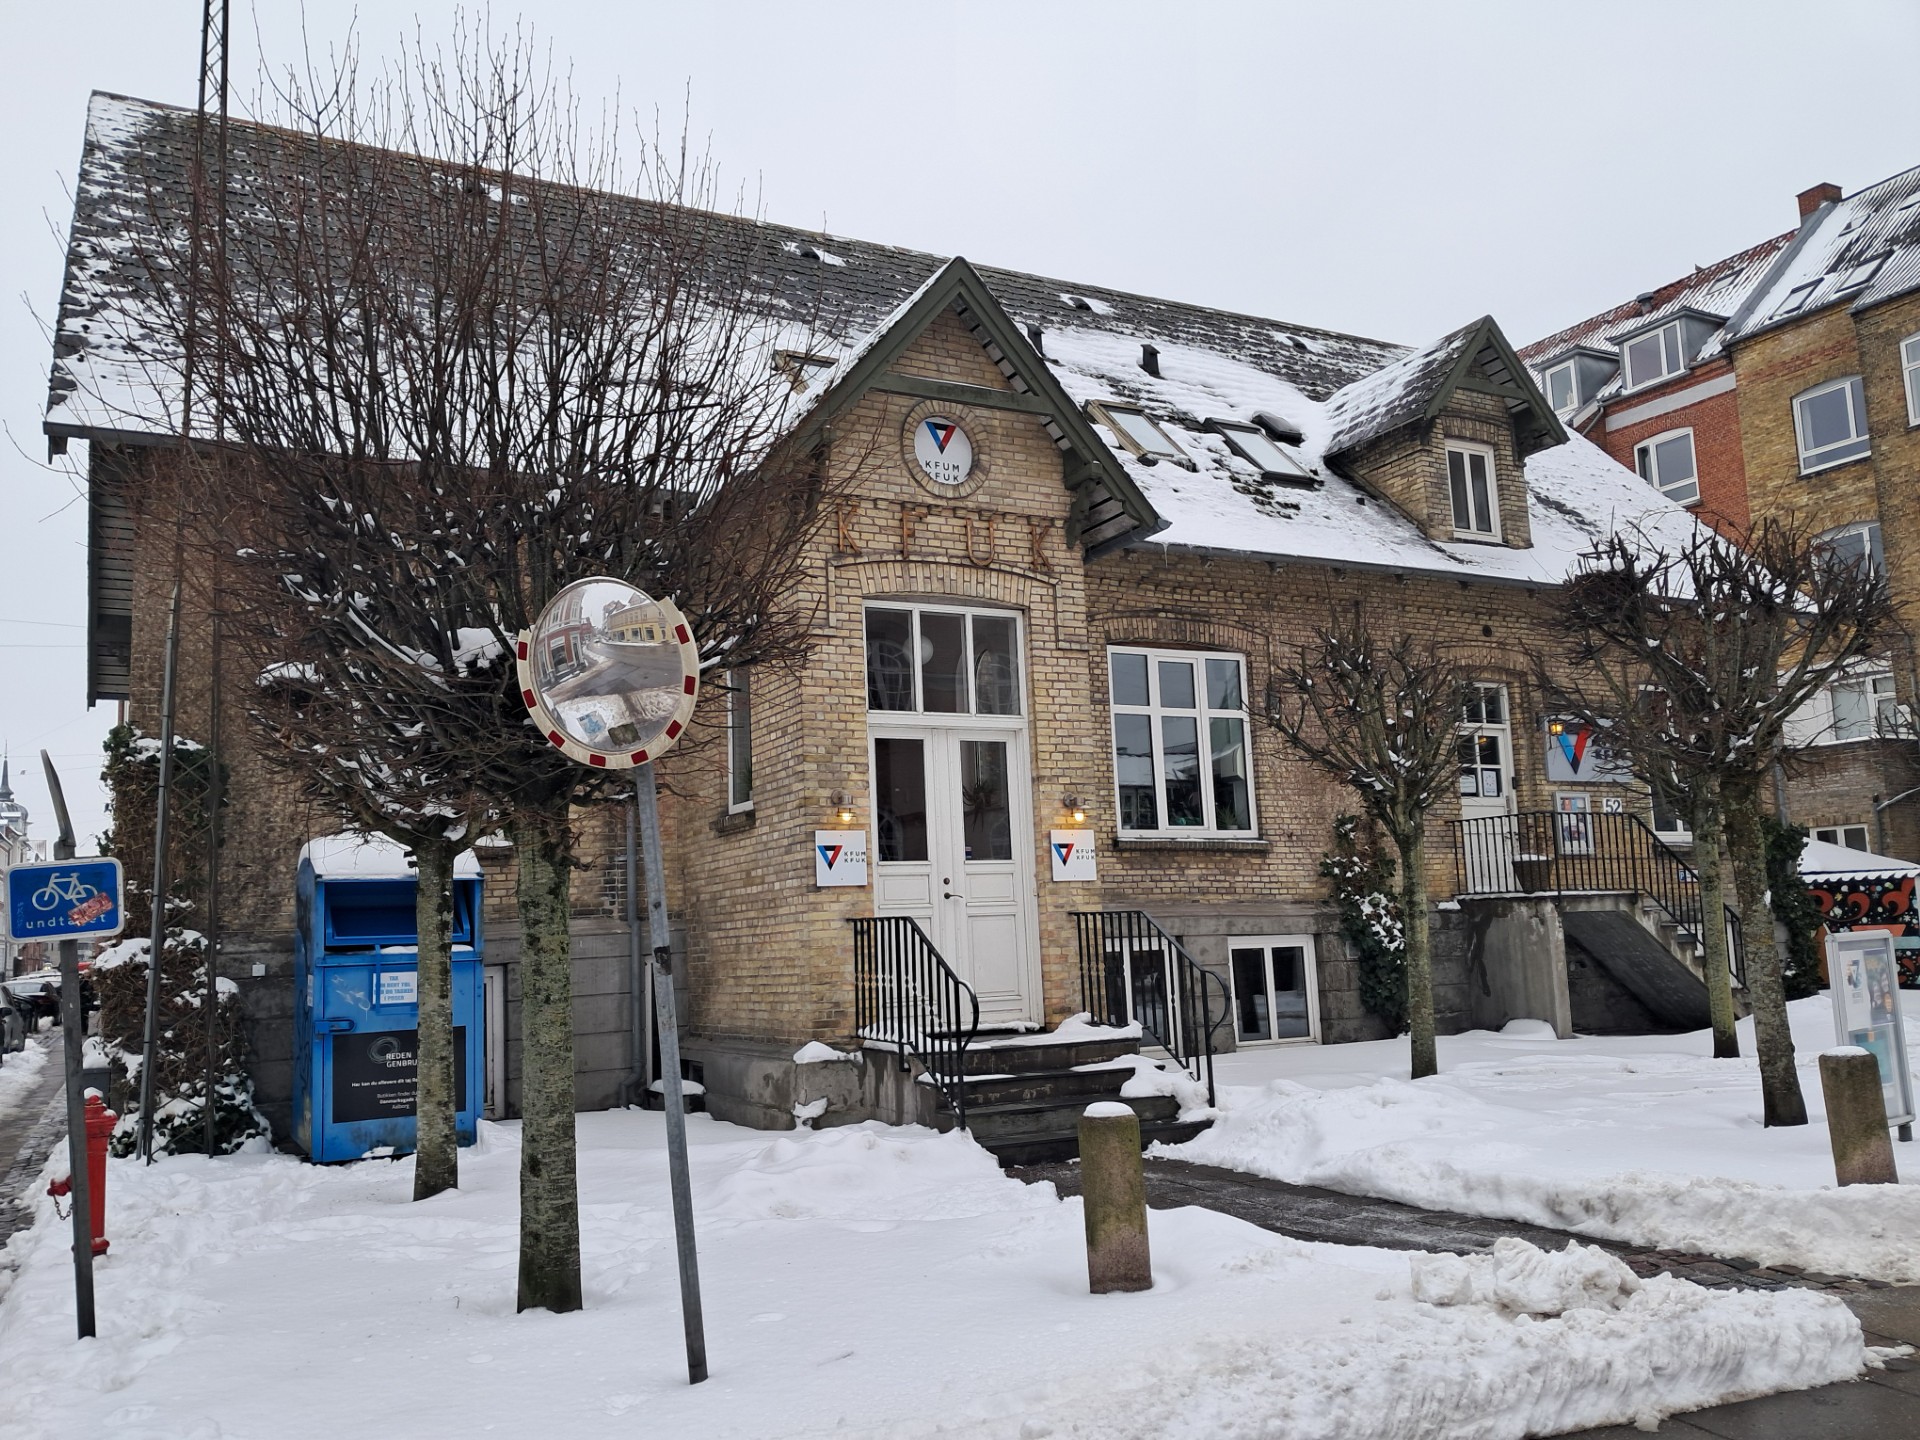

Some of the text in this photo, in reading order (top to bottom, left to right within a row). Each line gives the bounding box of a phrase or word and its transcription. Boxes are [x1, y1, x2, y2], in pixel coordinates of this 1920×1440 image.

[925, 460, 960, 473] KFUM
[1605, 799, 1621, 814] 52
[386, 1052, 412, 1060] REDEN
[386, 1059, 418, 1068] GENBRU
